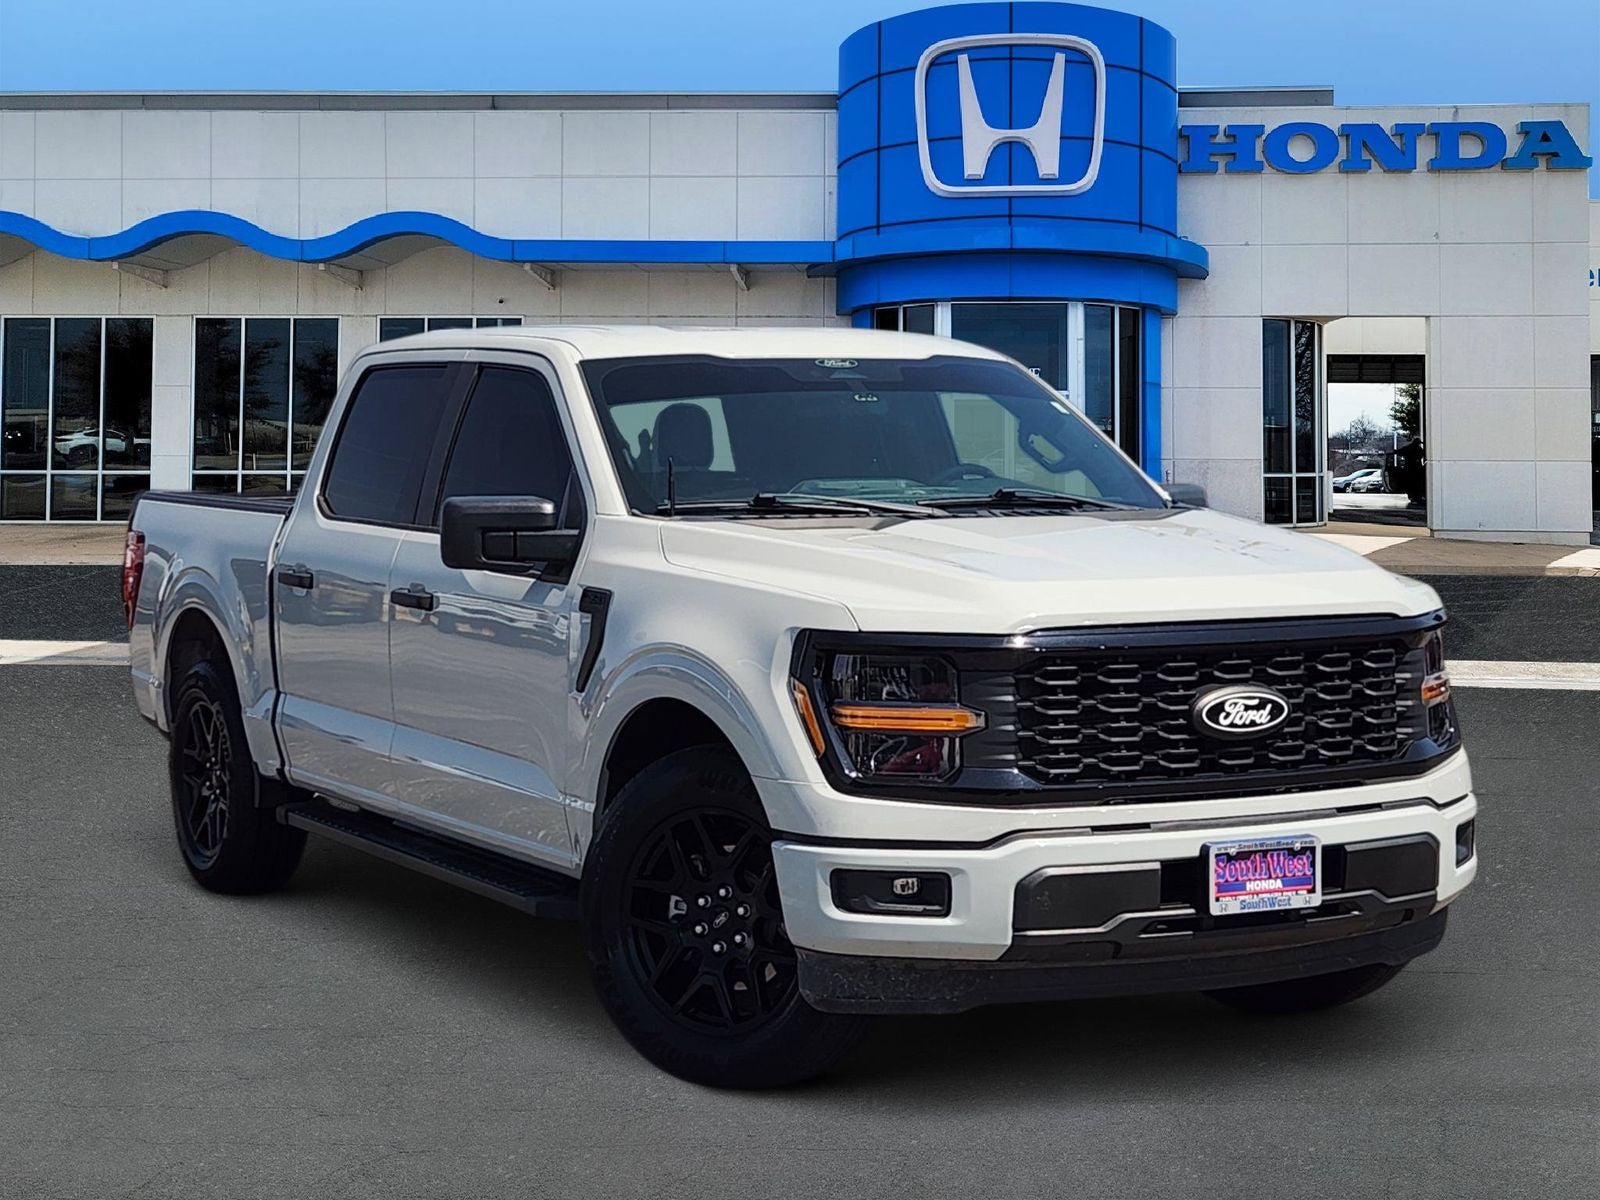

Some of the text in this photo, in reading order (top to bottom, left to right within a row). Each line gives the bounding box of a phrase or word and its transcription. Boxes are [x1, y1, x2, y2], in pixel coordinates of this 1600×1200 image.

[1178, 120, 1593, 173] HONDA
[1218, 698, 1273, 726] Ford
[1215, 851, 1313, 882] SouthWest
[1246, 879, 1283, 891] HONDA
[1239, 896, 1292, 911] SouthWest
